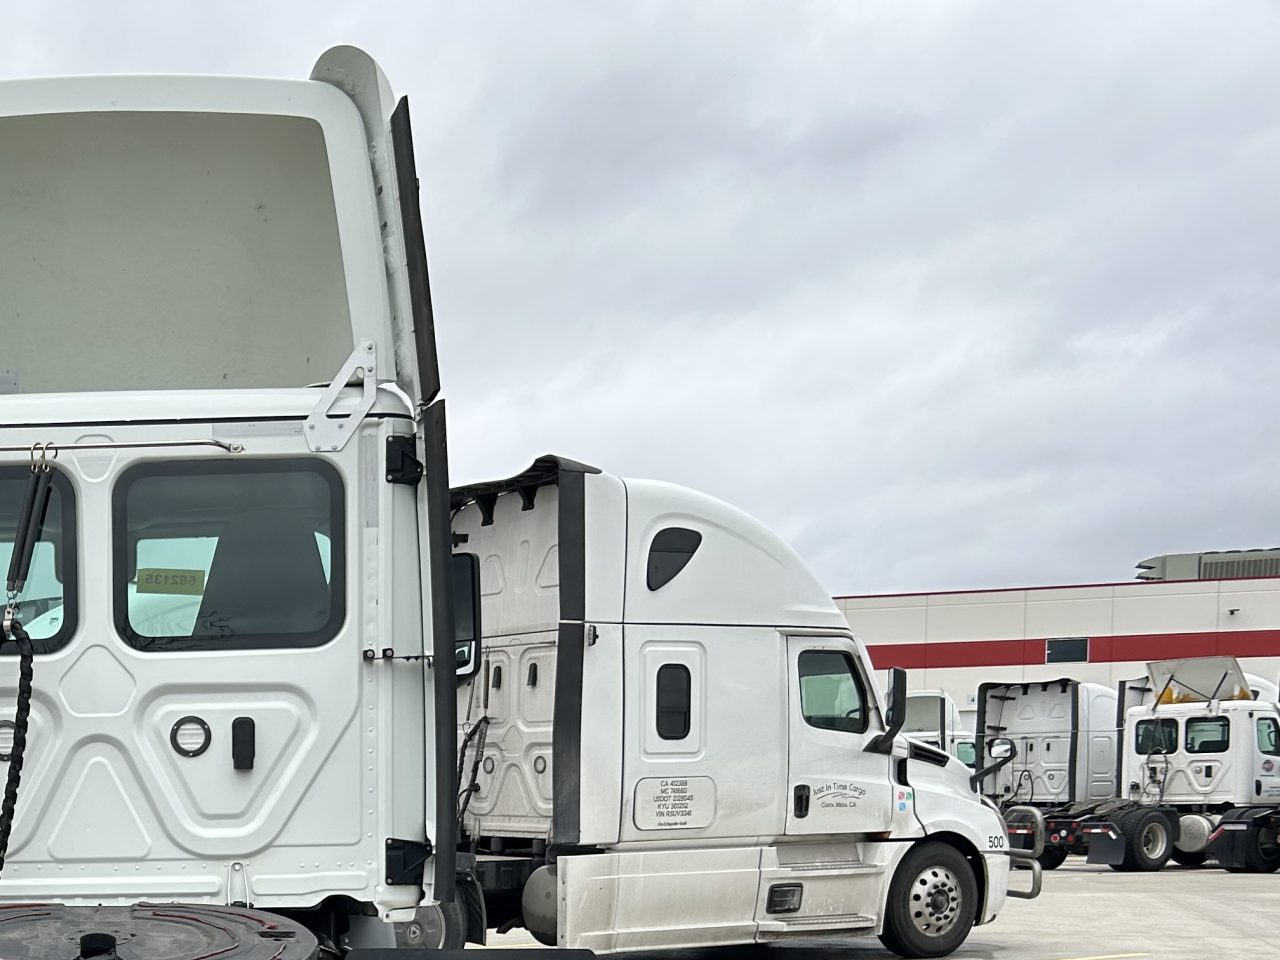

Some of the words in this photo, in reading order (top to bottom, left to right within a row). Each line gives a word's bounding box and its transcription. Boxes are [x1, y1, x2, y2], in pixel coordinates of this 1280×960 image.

[833, 782, 848, 791] Time
[849, 783, 867, 796] Cargo
[988, 835, 1004, 849] 500
